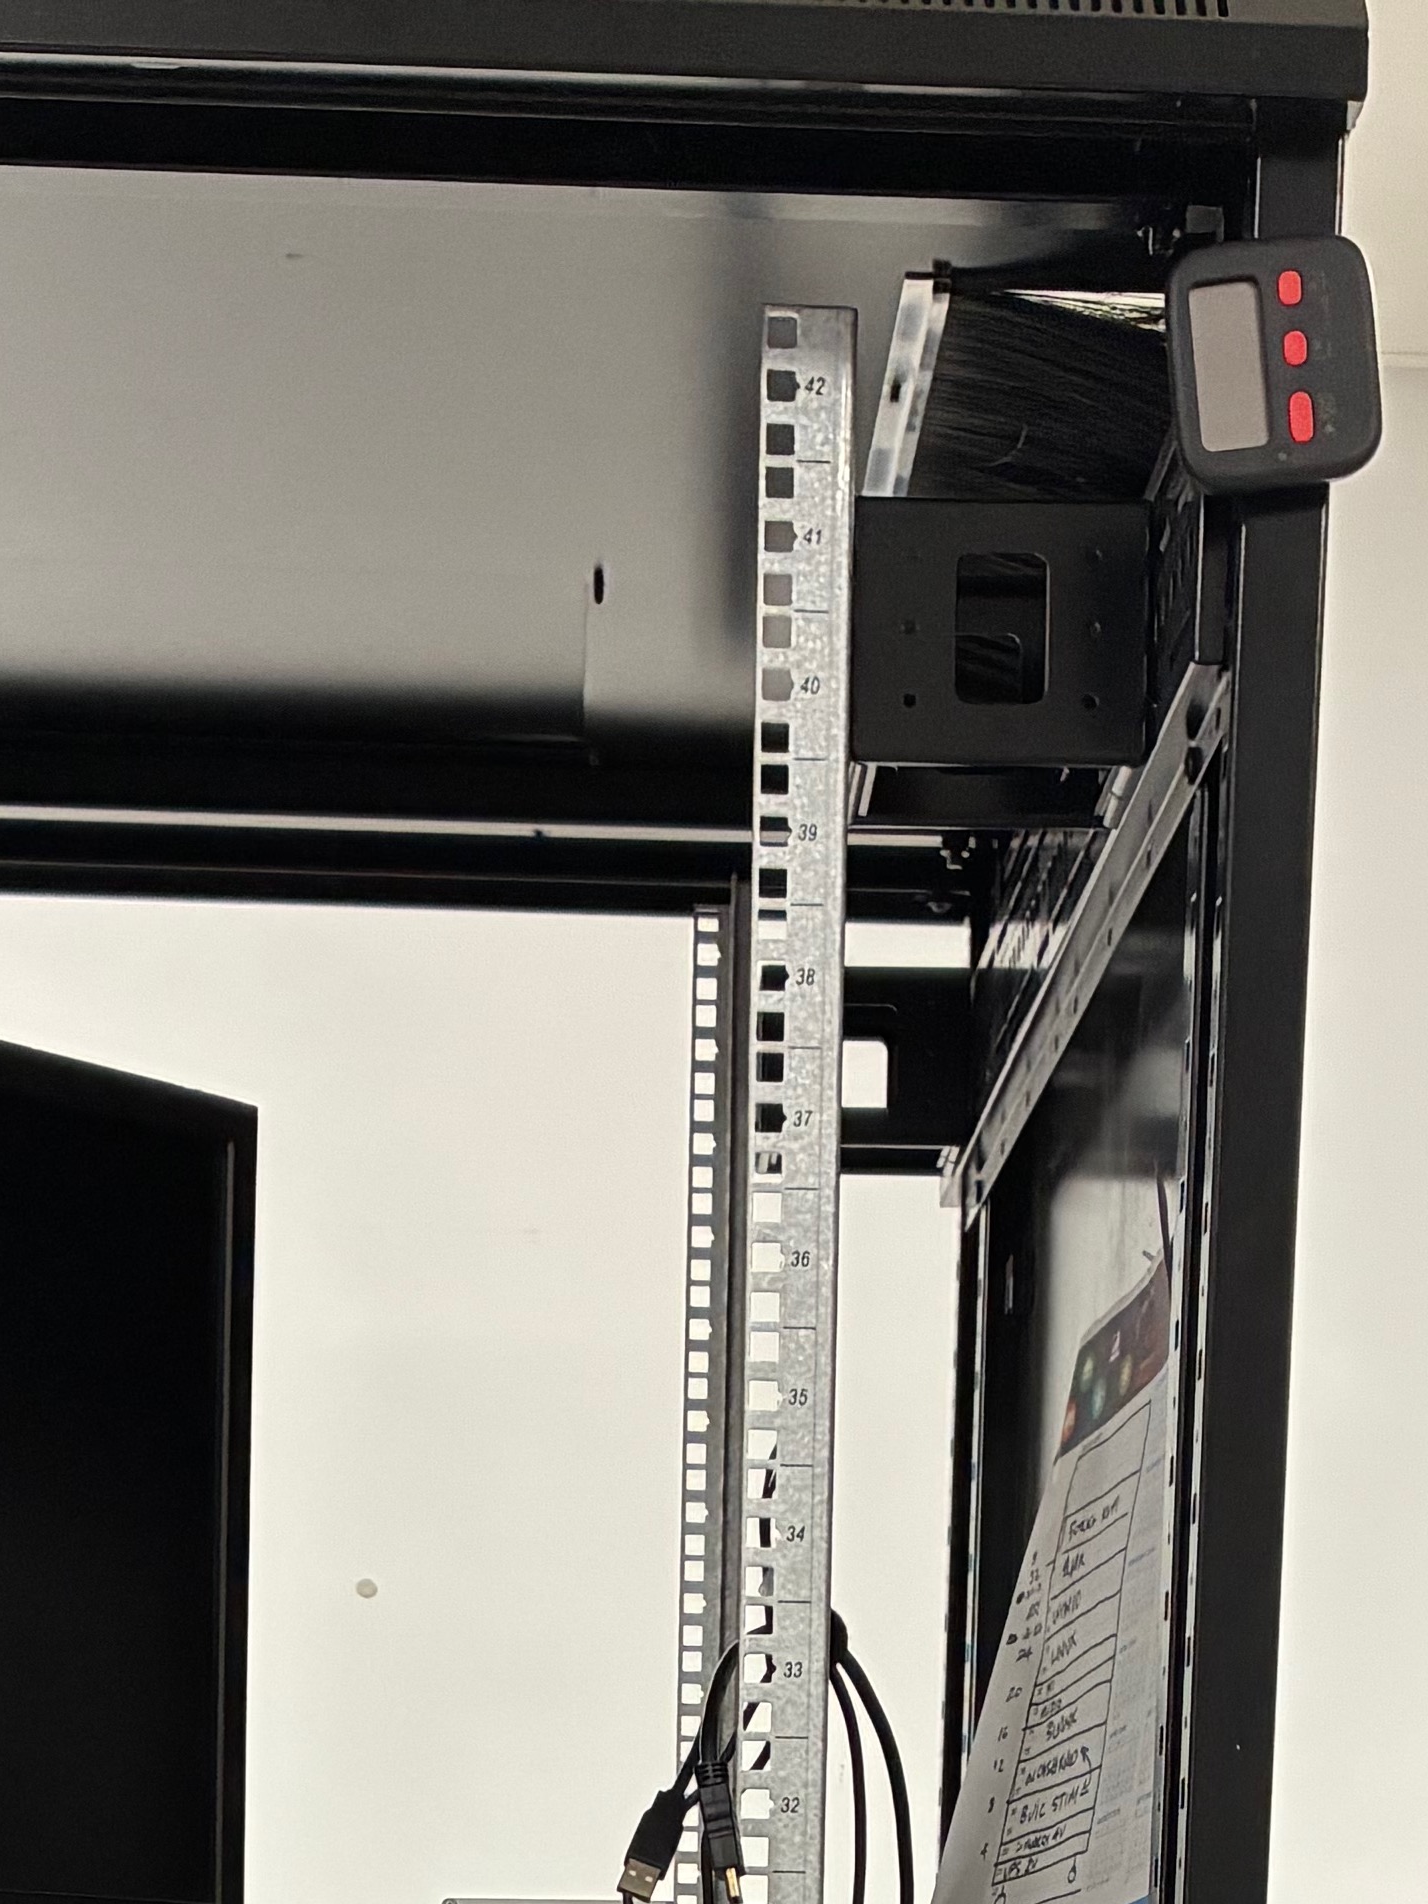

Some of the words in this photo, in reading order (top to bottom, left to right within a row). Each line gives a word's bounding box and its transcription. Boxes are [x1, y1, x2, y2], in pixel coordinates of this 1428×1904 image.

[804, 376, 826, 396] 42
[803, 527, 822, 545] 41
[800, 676, 820, 695] 40
[797, 823, 818, 842] 39
[795, 968, 815, 986] 38
[792, 1110, 813, 1128] 37
[790, 1250, 811, 1268] 36
[787, 1388, 808, 1406] 35
[786, 1525, 805, 1542] 34
[783, 1662, 803, 1679] 33
[780, 1797, 800, 1813] 32
